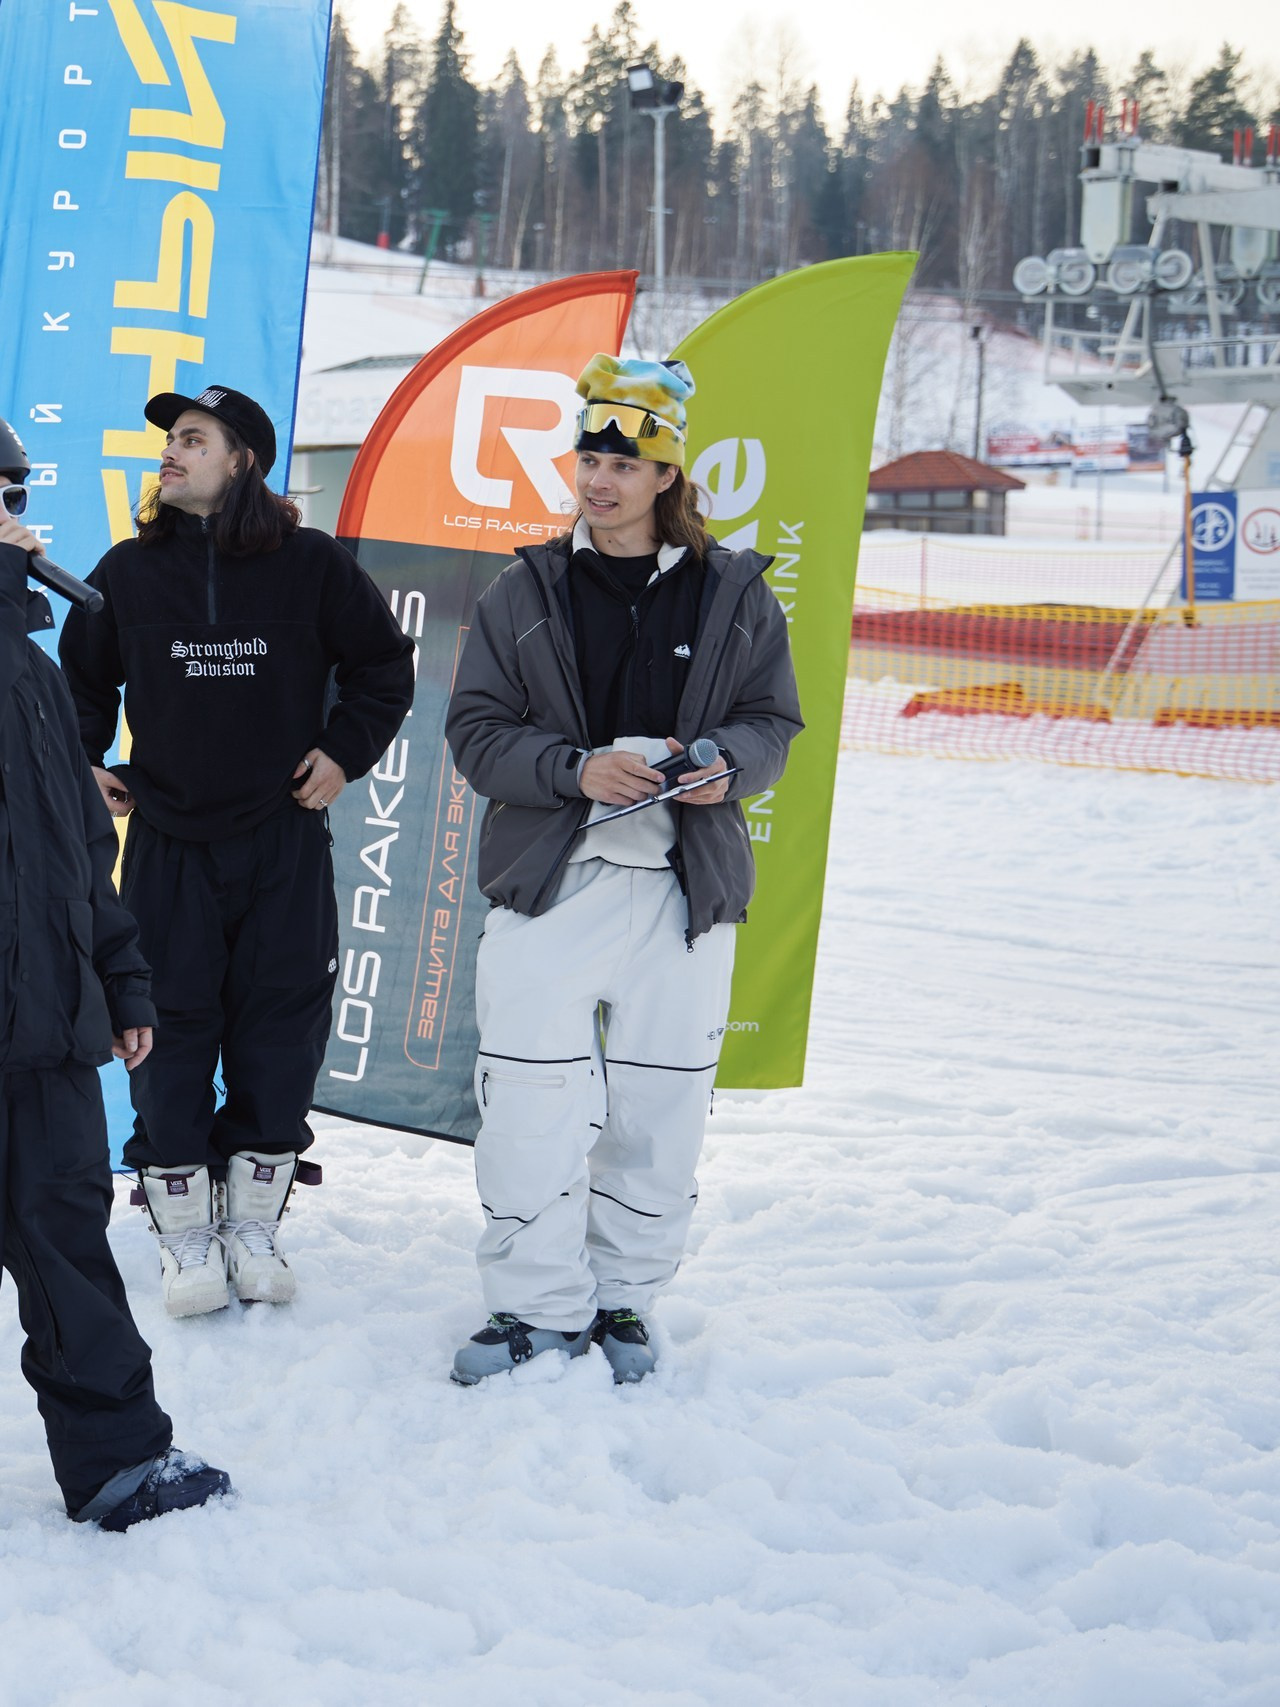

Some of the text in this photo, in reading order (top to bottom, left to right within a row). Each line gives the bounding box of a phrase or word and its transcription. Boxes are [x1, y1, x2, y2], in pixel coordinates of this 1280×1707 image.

[443, 514, 482, 529] LOS
[170, 637, 268, 660] Stronghold
[185, 659, 256, 678] Division
[329, 589, 427, 1082] LOS RAKES
